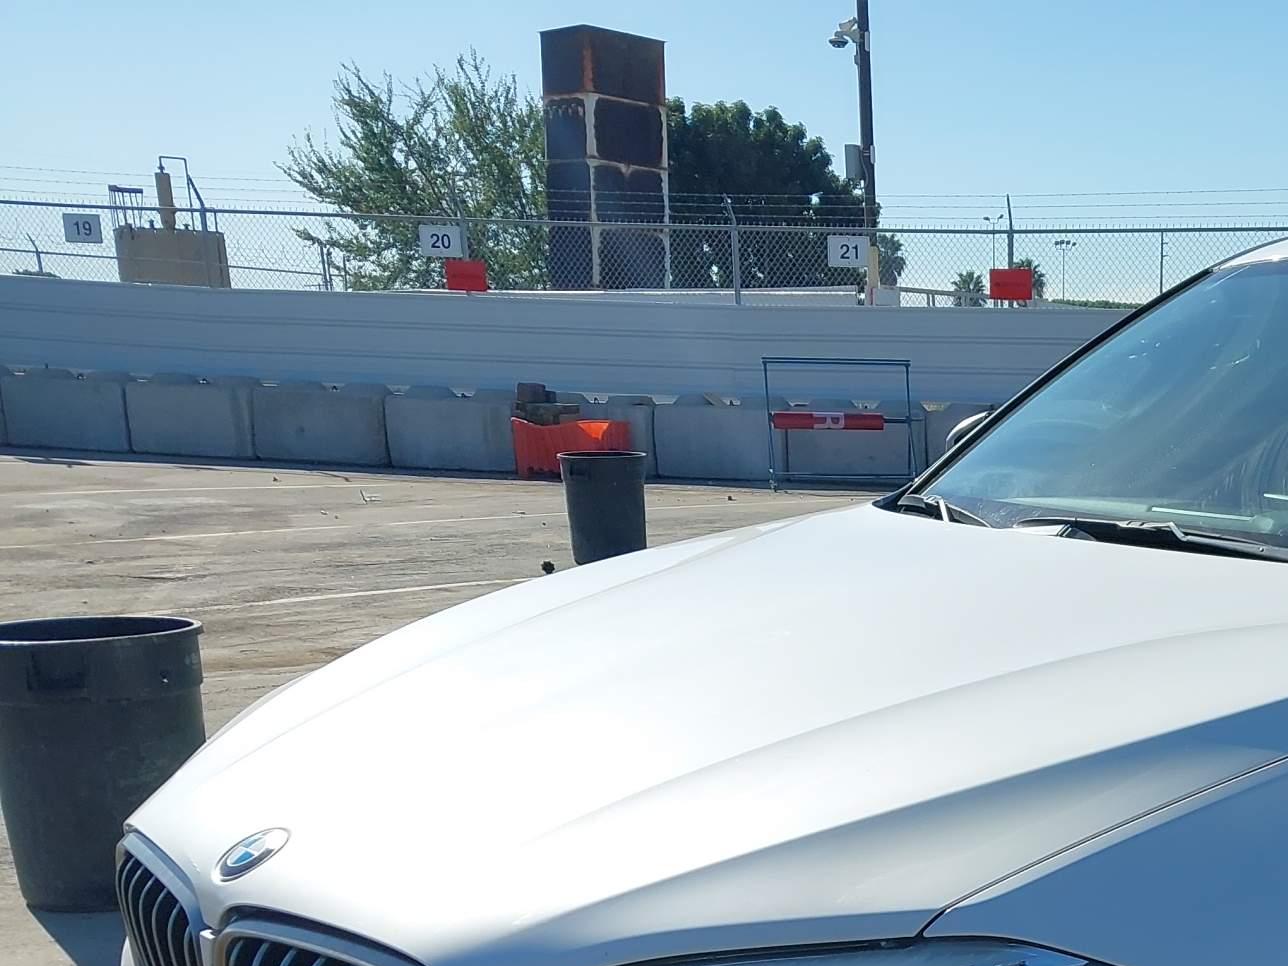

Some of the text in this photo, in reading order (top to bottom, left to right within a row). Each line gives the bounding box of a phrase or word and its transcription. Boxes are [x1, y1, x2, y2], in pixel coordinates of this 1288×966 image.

[73, 220, 92, 236] 19
[430, 233, 451, 249] 20
[839, 243, 859, 260] 21
